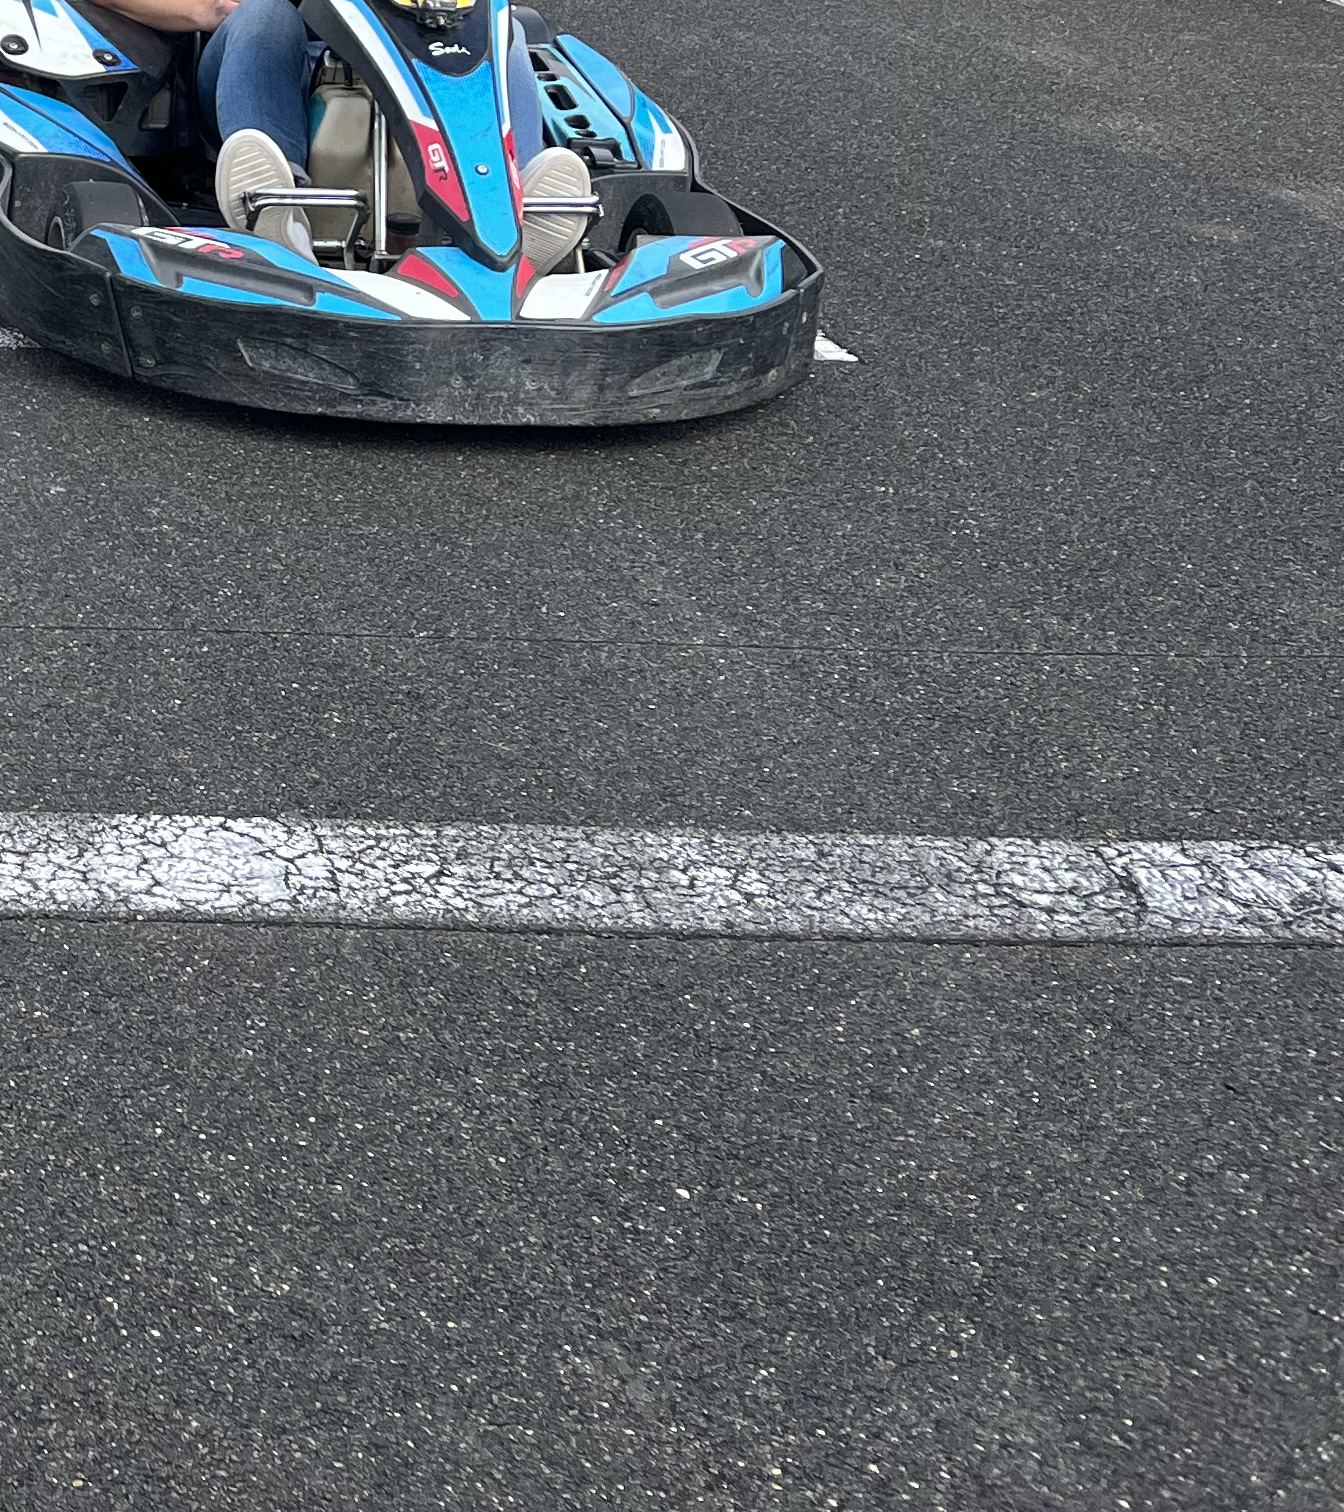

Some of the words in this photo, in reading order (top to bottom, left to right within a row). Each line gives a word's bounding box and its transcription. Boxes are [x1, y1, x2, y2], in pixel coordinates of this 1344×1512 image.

[427, 143, 450, 182] GTR
[130, 227, 245, 259] GTR
[679, 239, 758, 270] GTR
